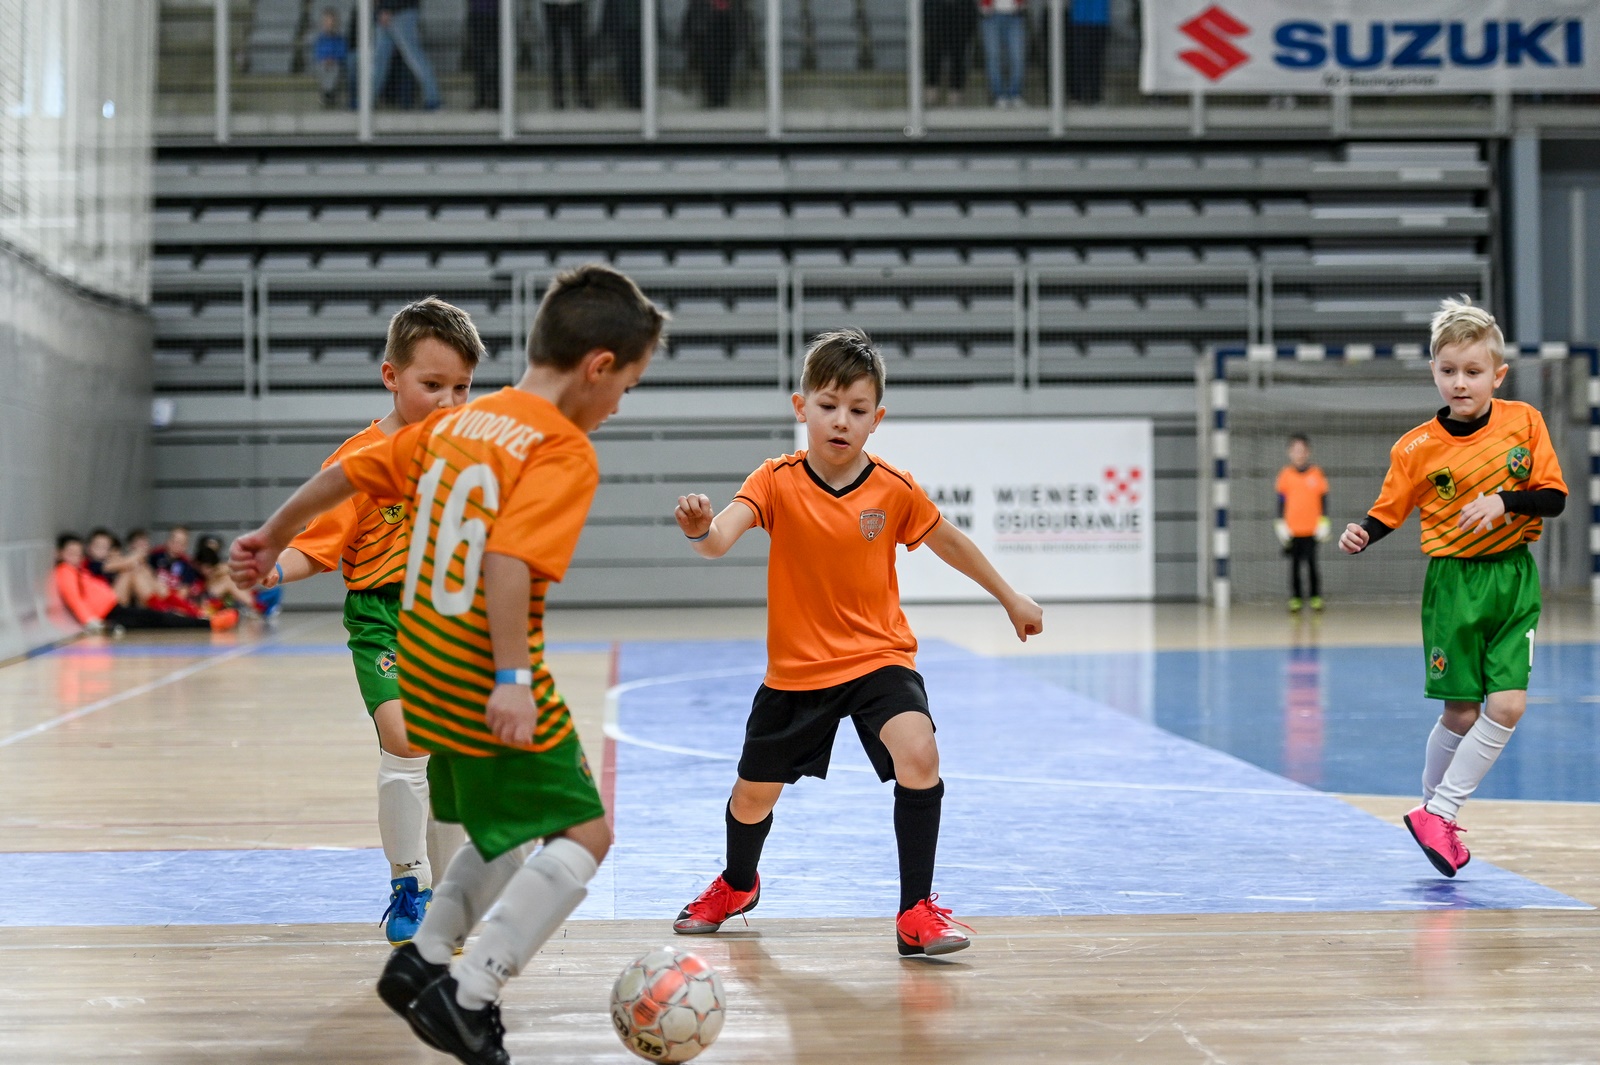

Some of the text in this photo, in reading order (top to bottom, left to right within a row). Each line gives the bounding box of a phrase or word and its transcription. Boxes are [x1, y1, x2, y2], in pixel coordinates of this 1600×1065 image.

[1272, 18, 1584, 70] SUZUKI
[451, 408, 545, 462] VIDOVEC
[922, 487, 974, 505] AM
[995, 486, 1099, 505] WIENER
[402, 458, 499, 616] 16
[994, 511, 1142, 533] OSIGURANJE
